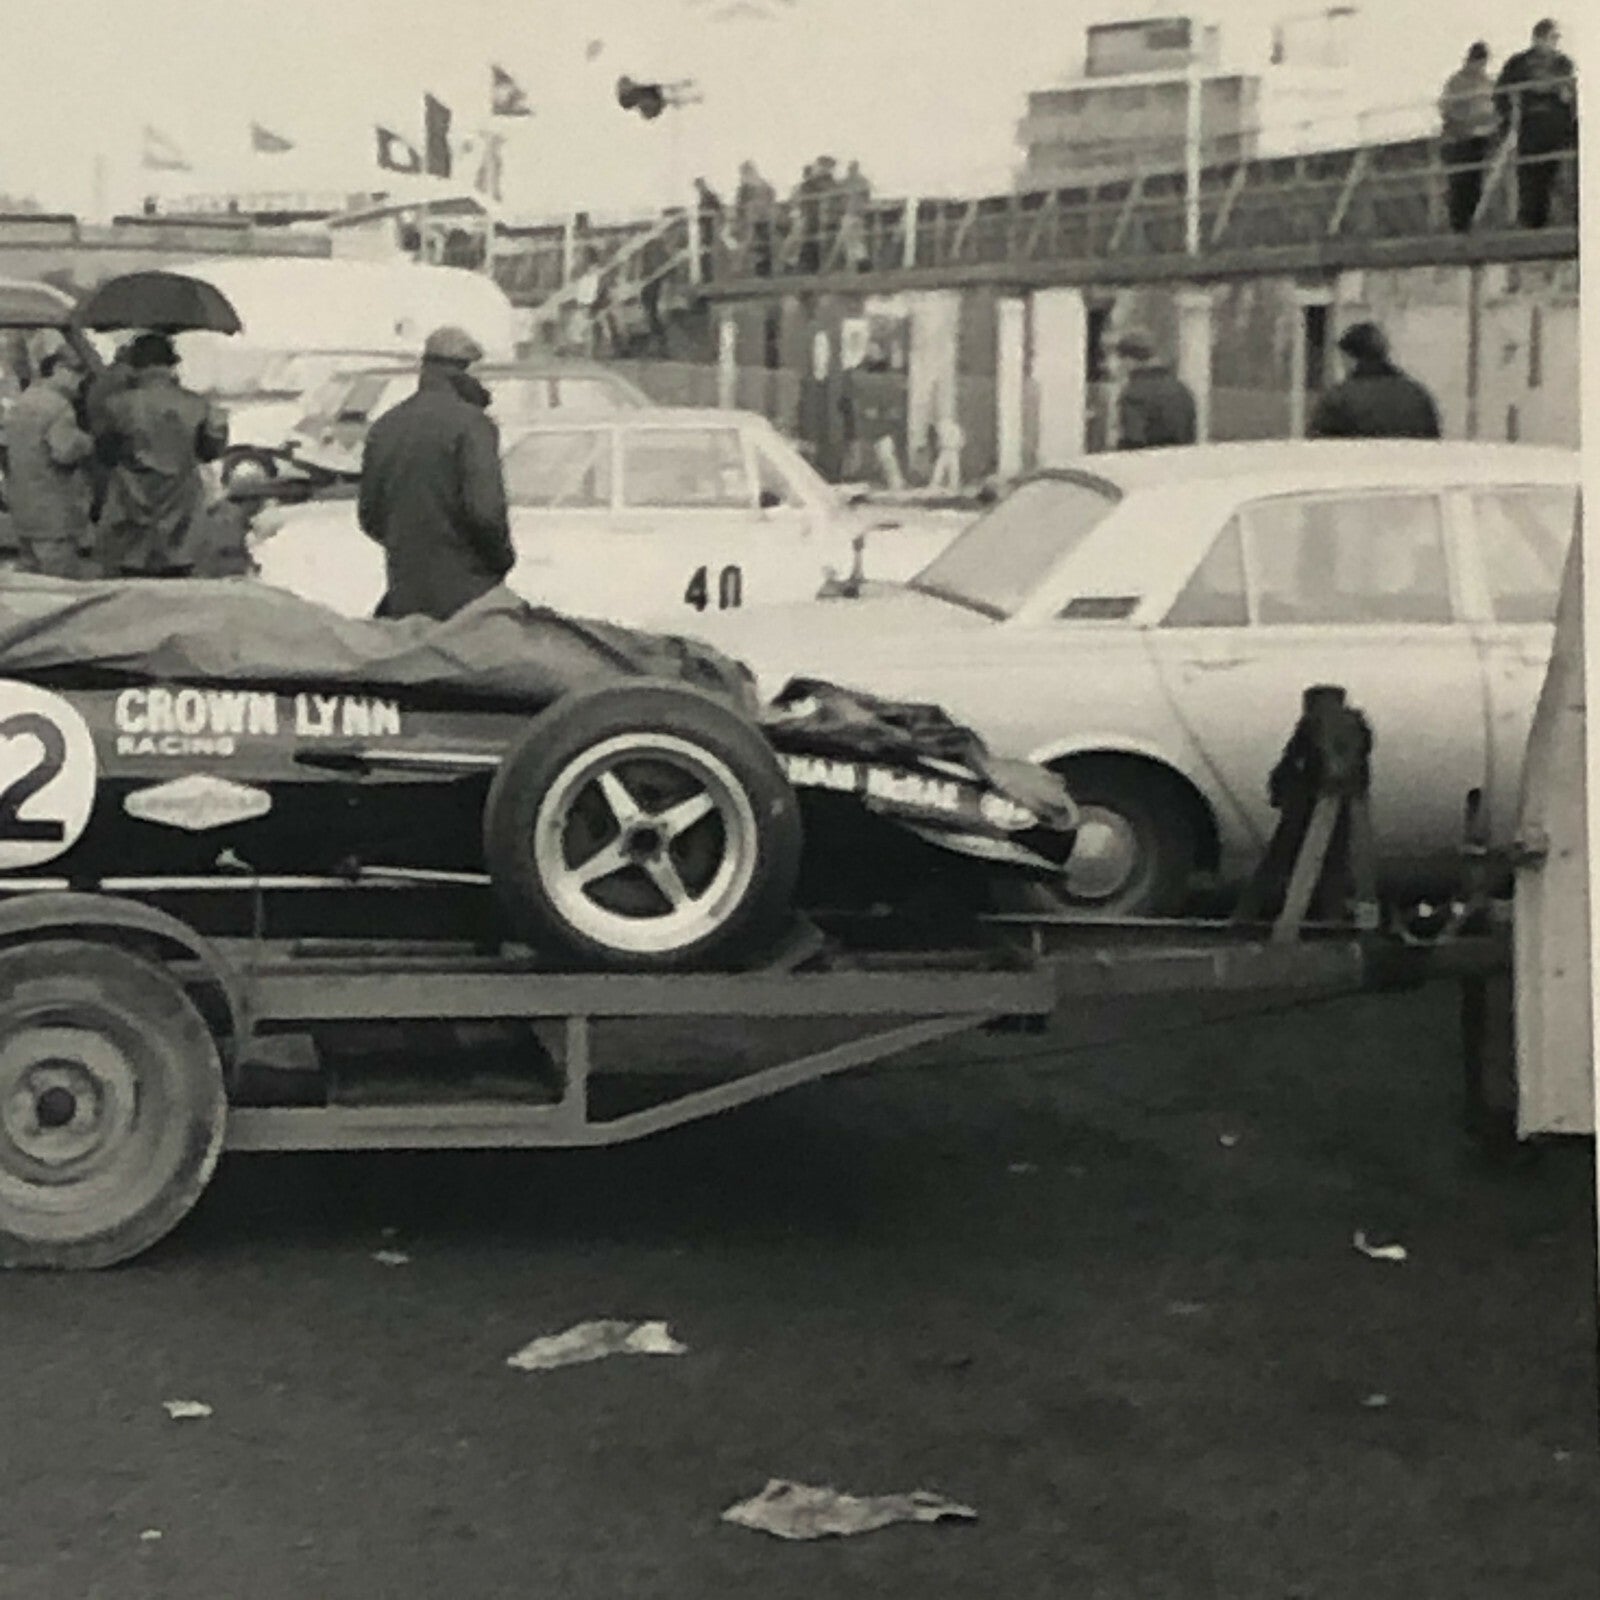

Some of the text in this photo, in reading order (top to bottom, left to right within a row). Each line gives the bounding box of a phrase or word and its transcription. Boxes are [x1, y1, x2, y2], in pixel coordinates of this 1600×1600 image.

[684, 565, 742, 612] 40
[115, 688, 401, 736] CROWN LYNN
[116, 736, 235, 756] RACING
